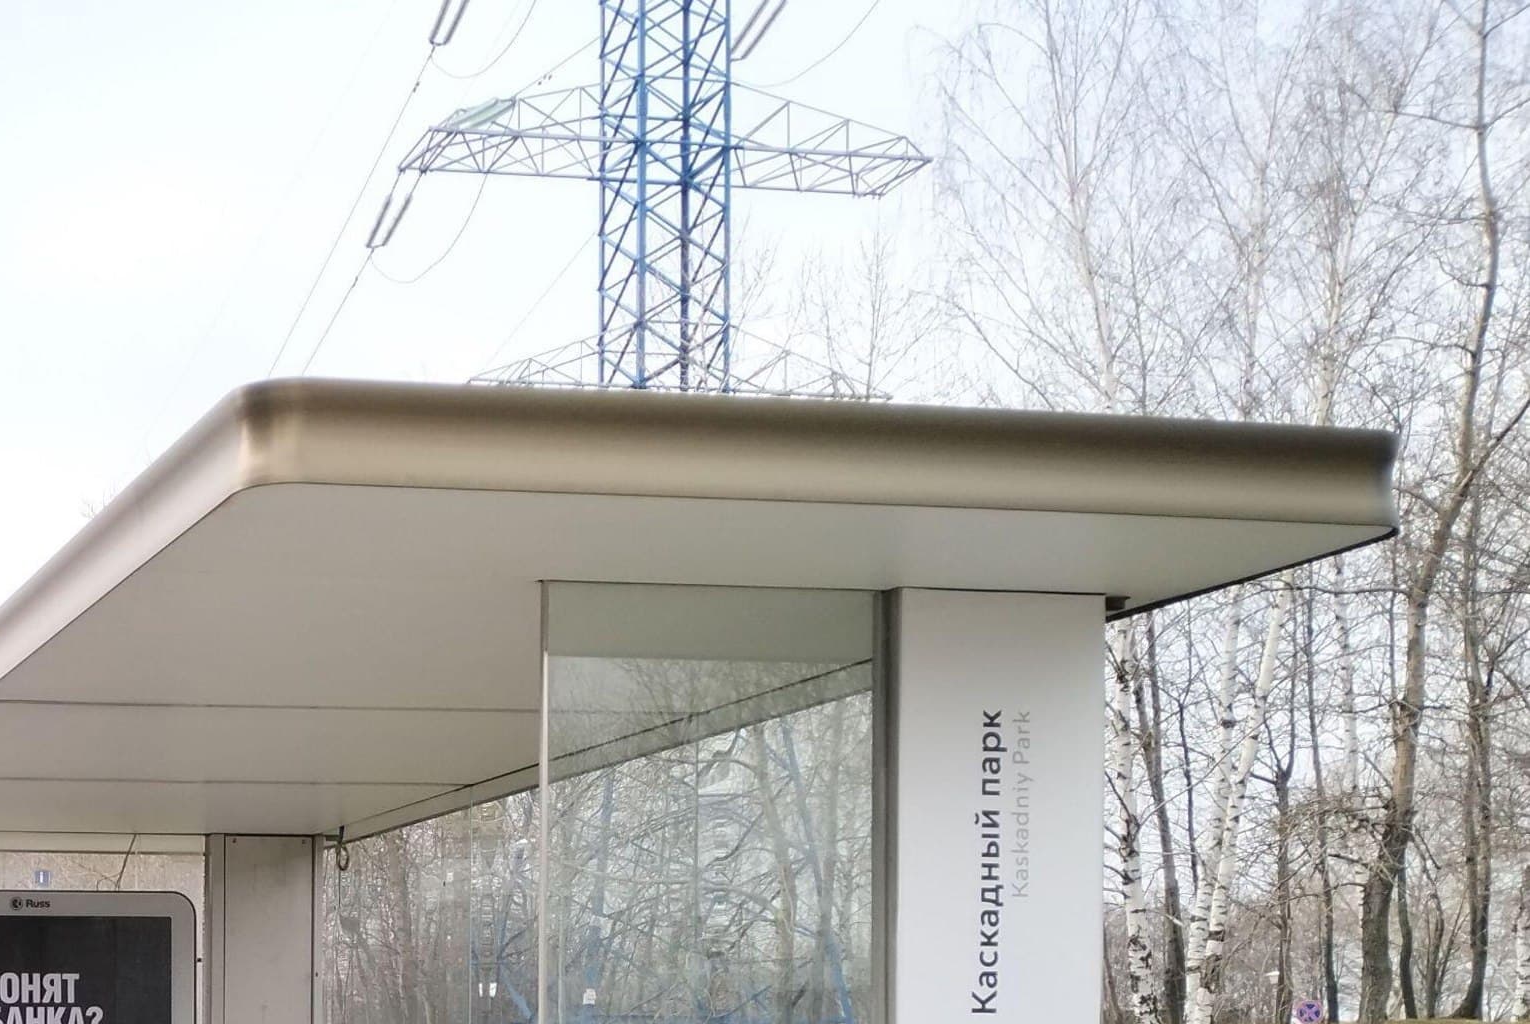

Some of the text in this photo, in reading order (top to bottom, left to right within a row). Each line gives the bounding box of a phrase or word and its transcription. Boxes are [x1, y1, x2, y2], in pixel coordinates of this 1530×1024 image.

[972, 710, 1008, 1013] Каскадный парк
[1011, 711, 1036, 897] Kaskadniy Park
[26, 899, 50, 908] Russ
